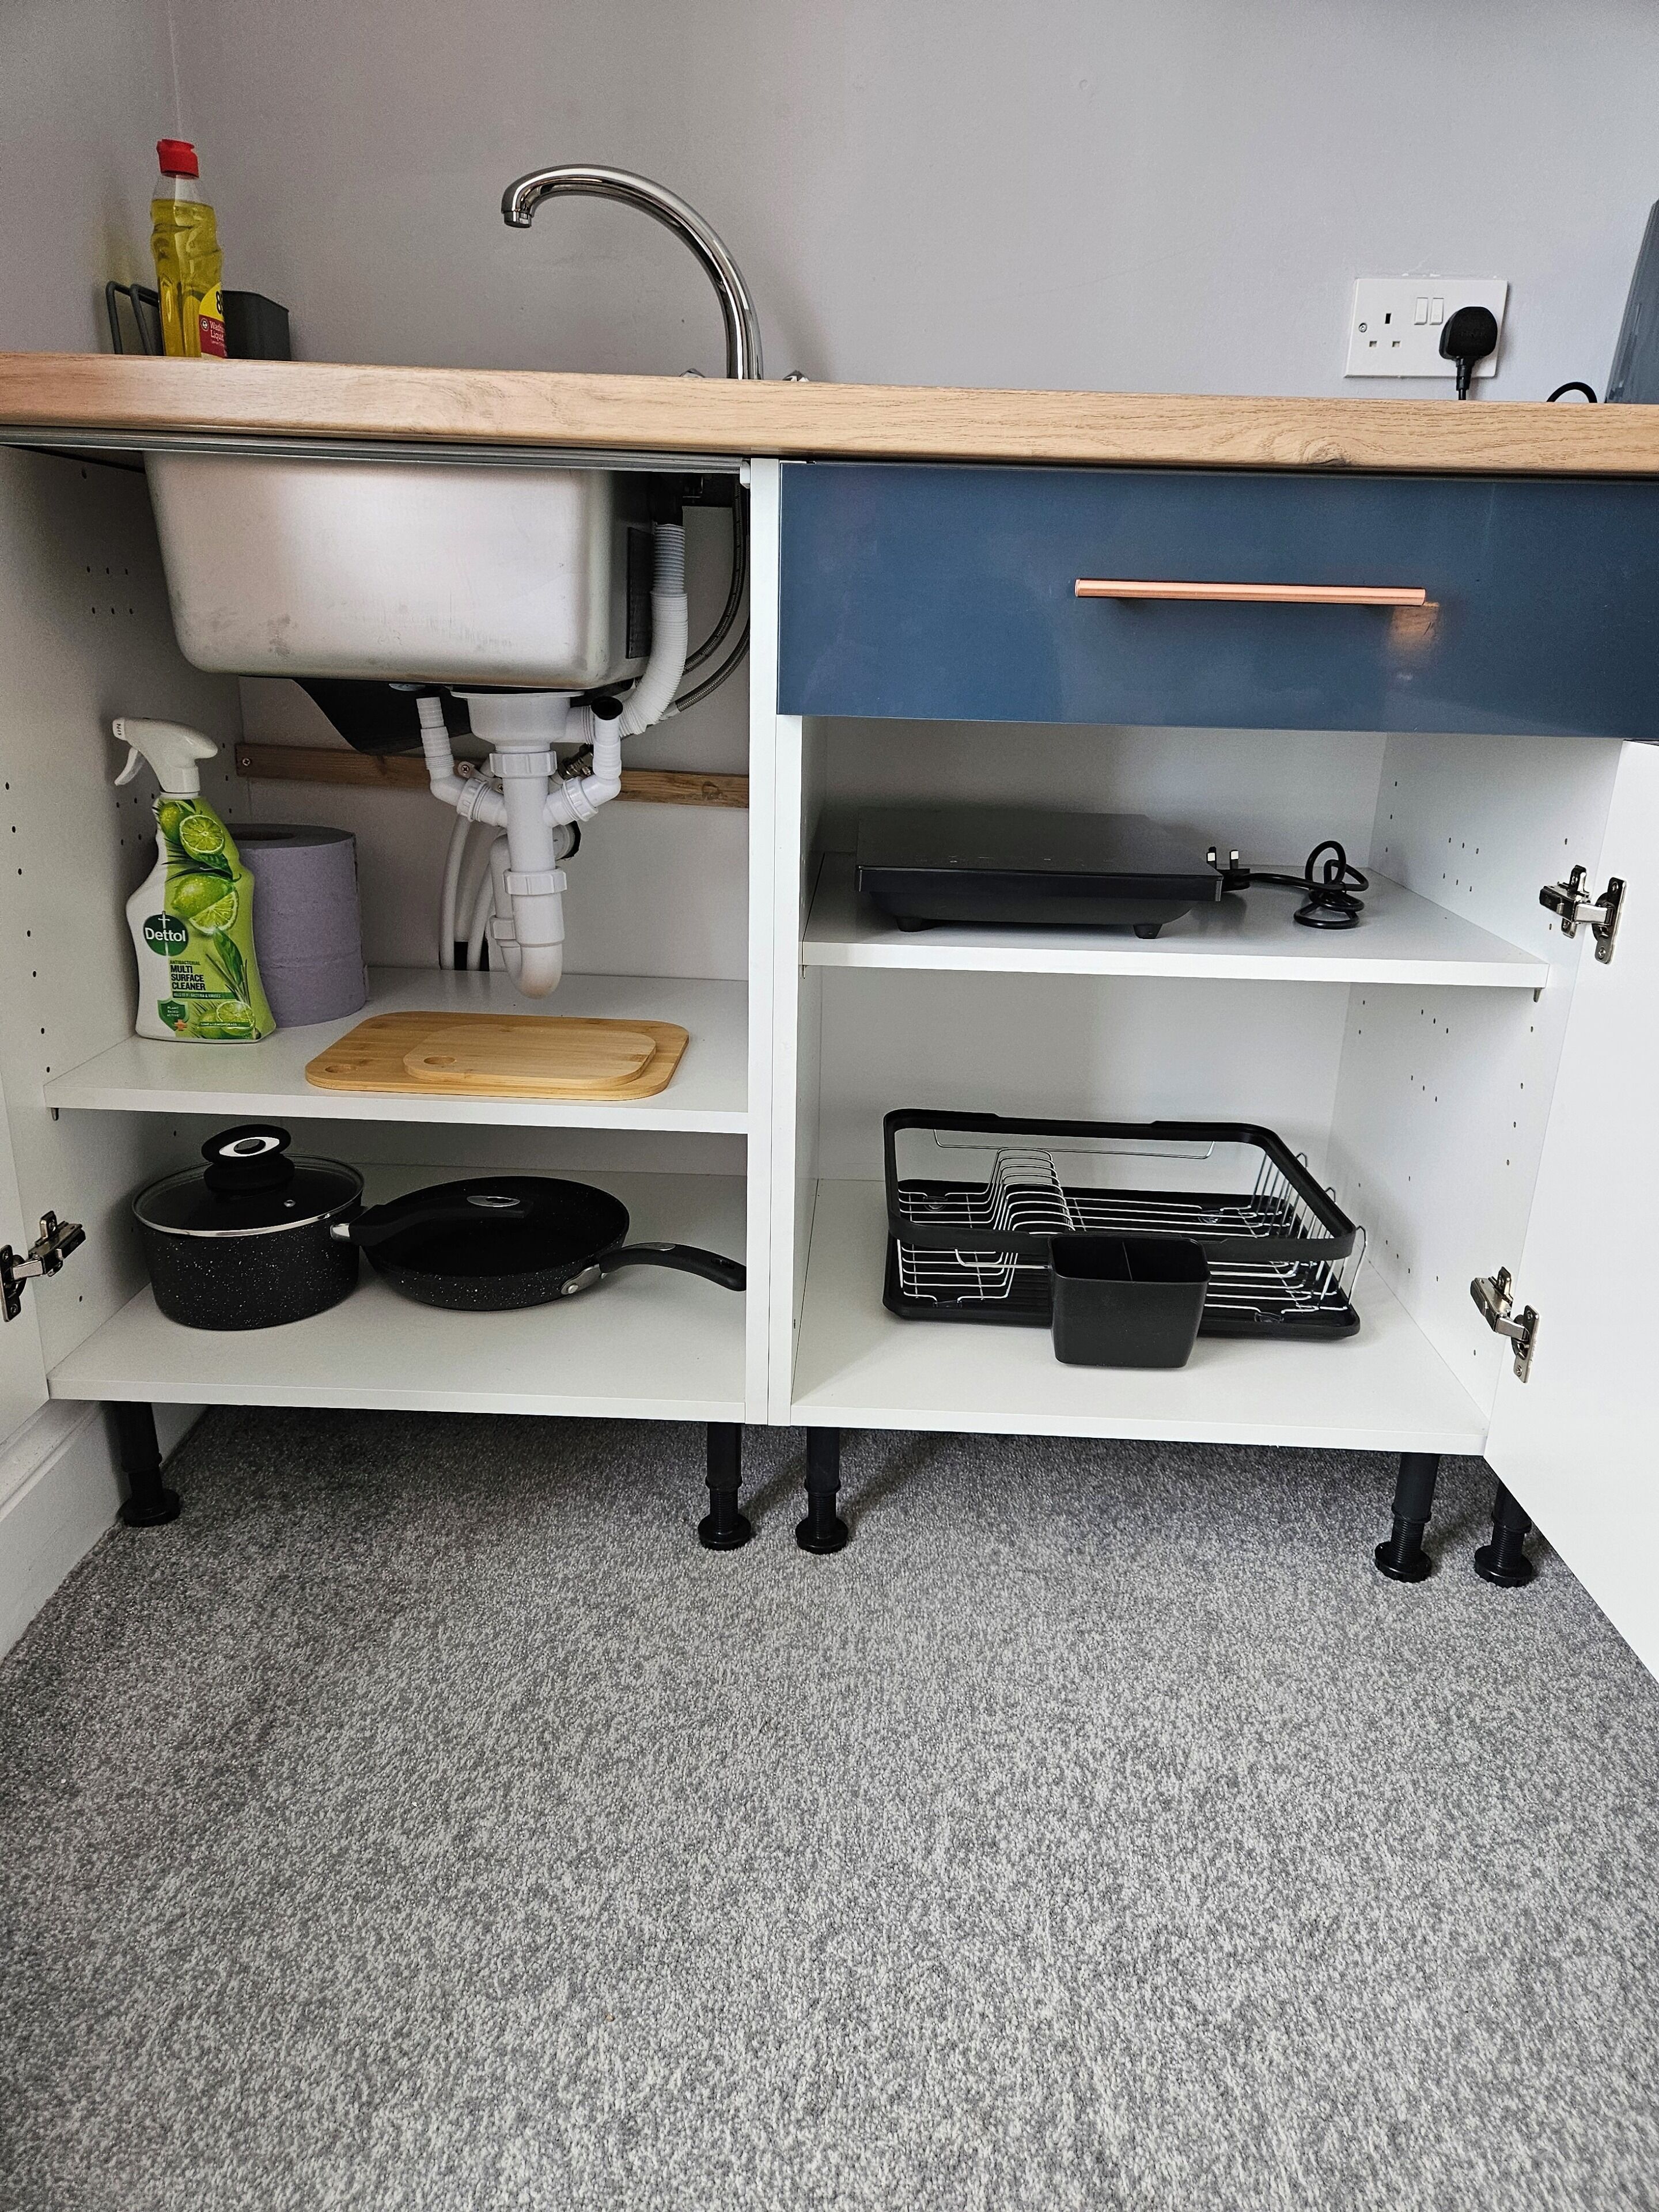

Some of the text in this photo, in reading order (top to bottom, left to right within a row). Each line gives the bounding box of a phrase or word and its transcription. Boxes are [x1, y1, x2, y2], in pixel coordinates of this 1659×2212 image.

[145, 927, 186, 942] Dettol
[171, 965, 193, 974] MULTI
[171, 974, 204, 982] SURFACE
[172, 982, 206, 991] CLEANER
